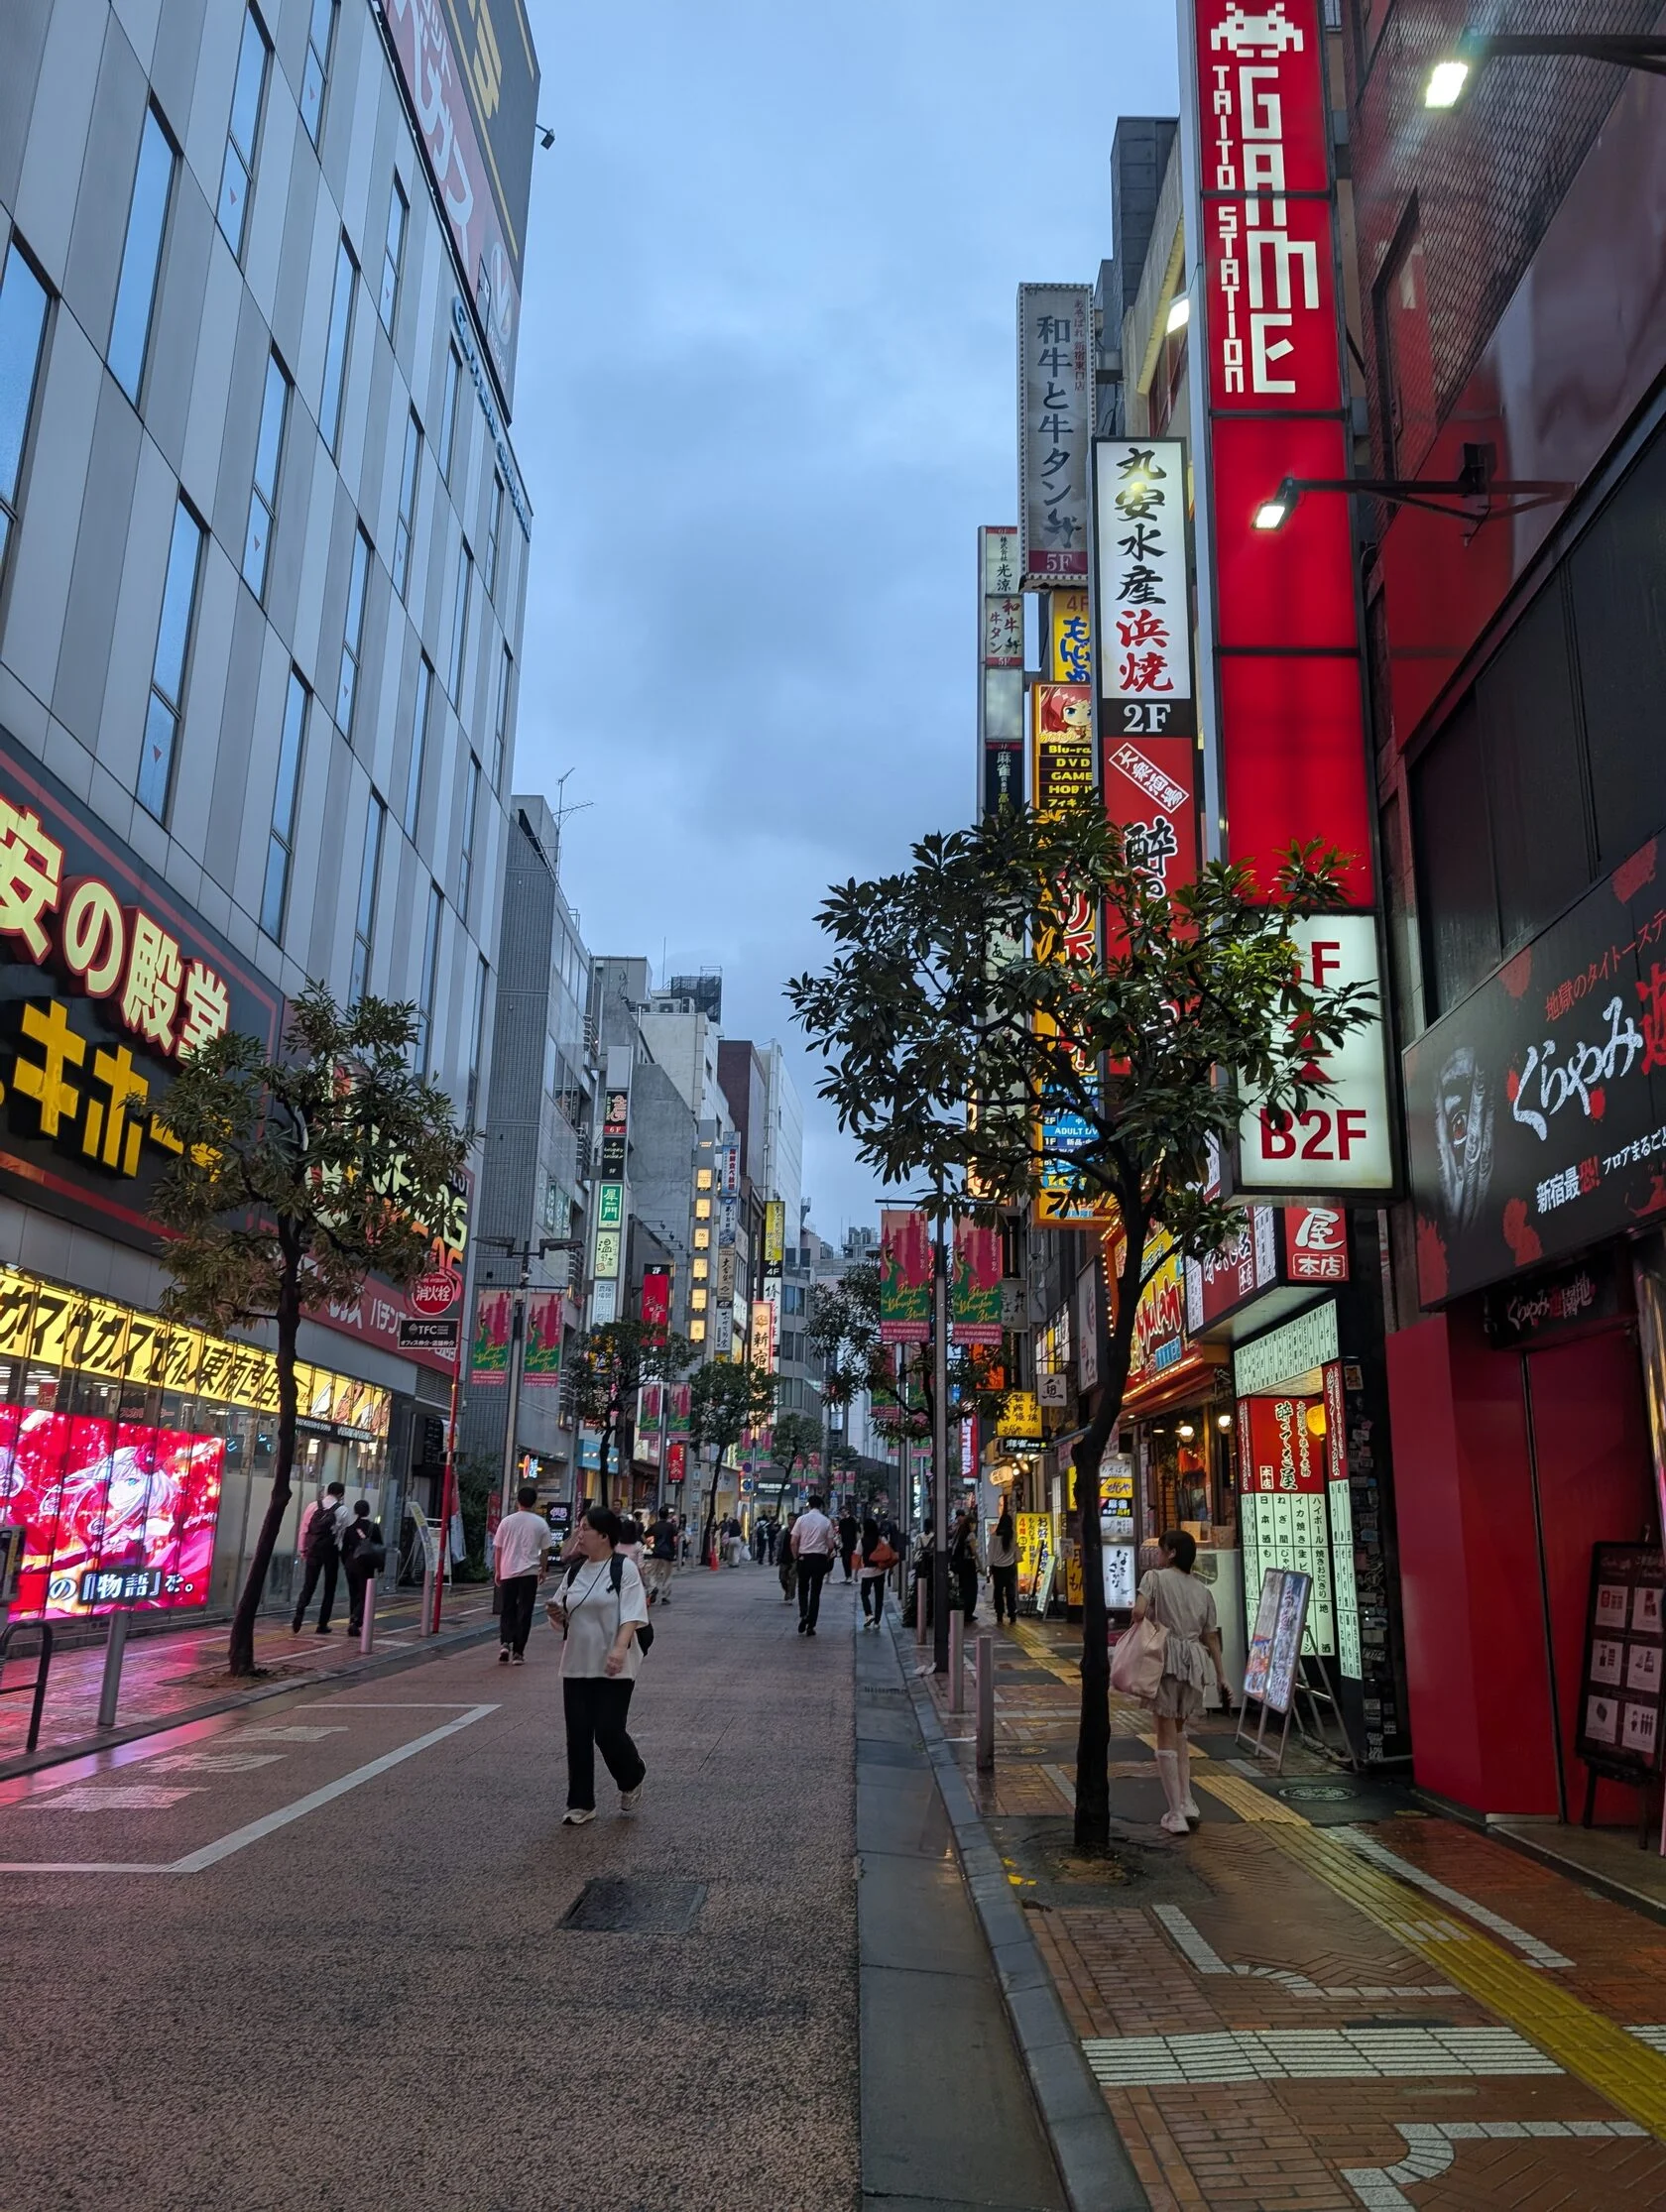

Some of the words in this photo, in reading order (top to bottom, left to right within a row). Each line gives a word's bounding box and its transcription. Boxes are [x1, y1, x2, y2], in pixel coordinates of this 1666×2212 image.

[1212, 65, 1236, 190] TAITO
[1239, 65, 1319, 394] GAME
[1219, 205, 1244, 394] STATION
[1046, 554, 1072, 572] 5F
[1115, 608, 1174, 692] 浜焼
[1123, 703, 1171, 733] 2F
[1048, 745, 1092, 755] Blu-ra
[1259, 1107, 1368, 1161] B2F
[1298, 1255, 1342, 1276] 本店
[416, 1285, 451, 1302] 消火栓
[417, 1326, 438, 1336] TFC
[1041, 1378, 1064, 1399] 魚
[1259, 1495, 1271, 1545] 日本酒
[1295, 1496, 1306, 1545] イカ焼き
[1312, 1497, 1325, 1545] ハイボール
[1315, 1549, 1327, 1599] 焼きおにぎり
[1319, 1602, 1332, 1654] 地酒
